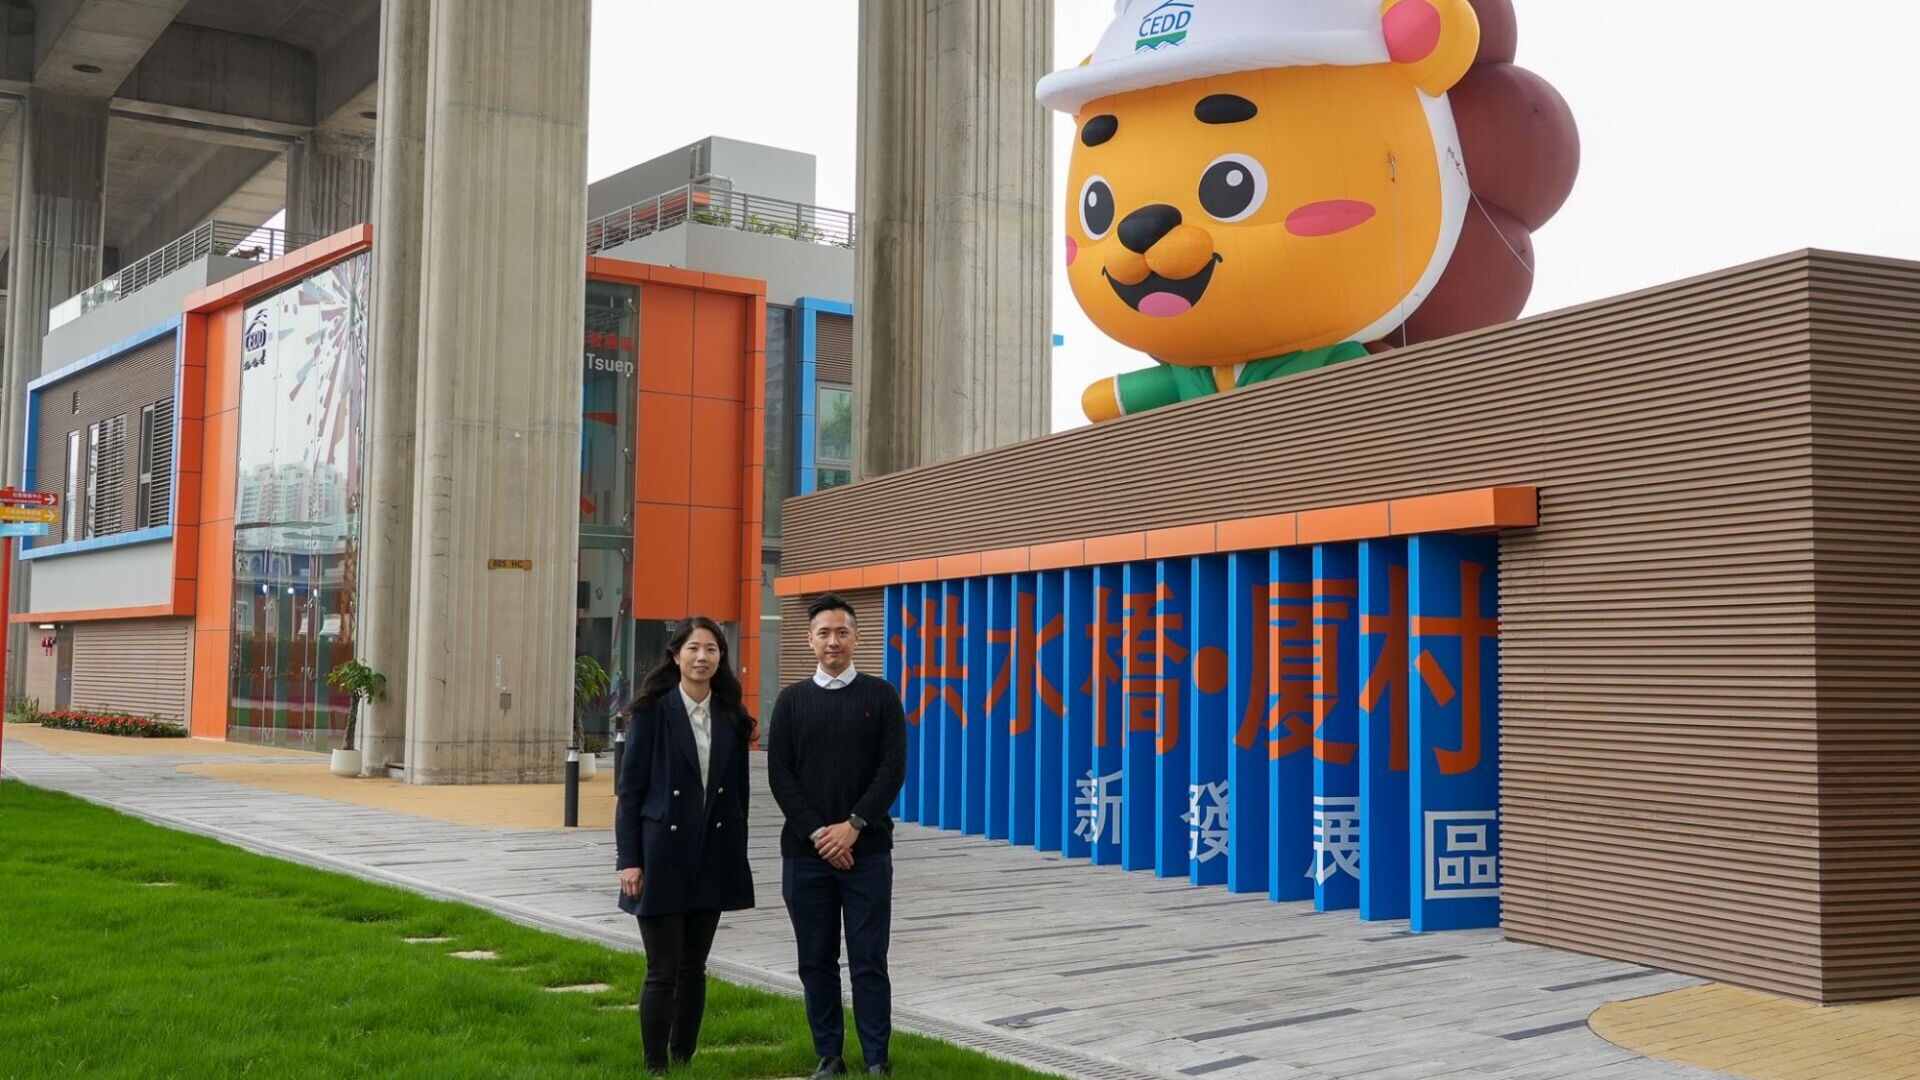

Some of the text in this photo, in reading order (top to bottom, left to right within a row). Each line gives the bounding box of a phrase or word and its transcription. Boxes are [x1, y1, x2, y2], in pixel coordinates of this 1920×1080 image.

[1139, 10, 1192, 38] CEDD
[586, 352, 634, 375] Tsuen
[1073, 769, 1499, 900] 新發展區
